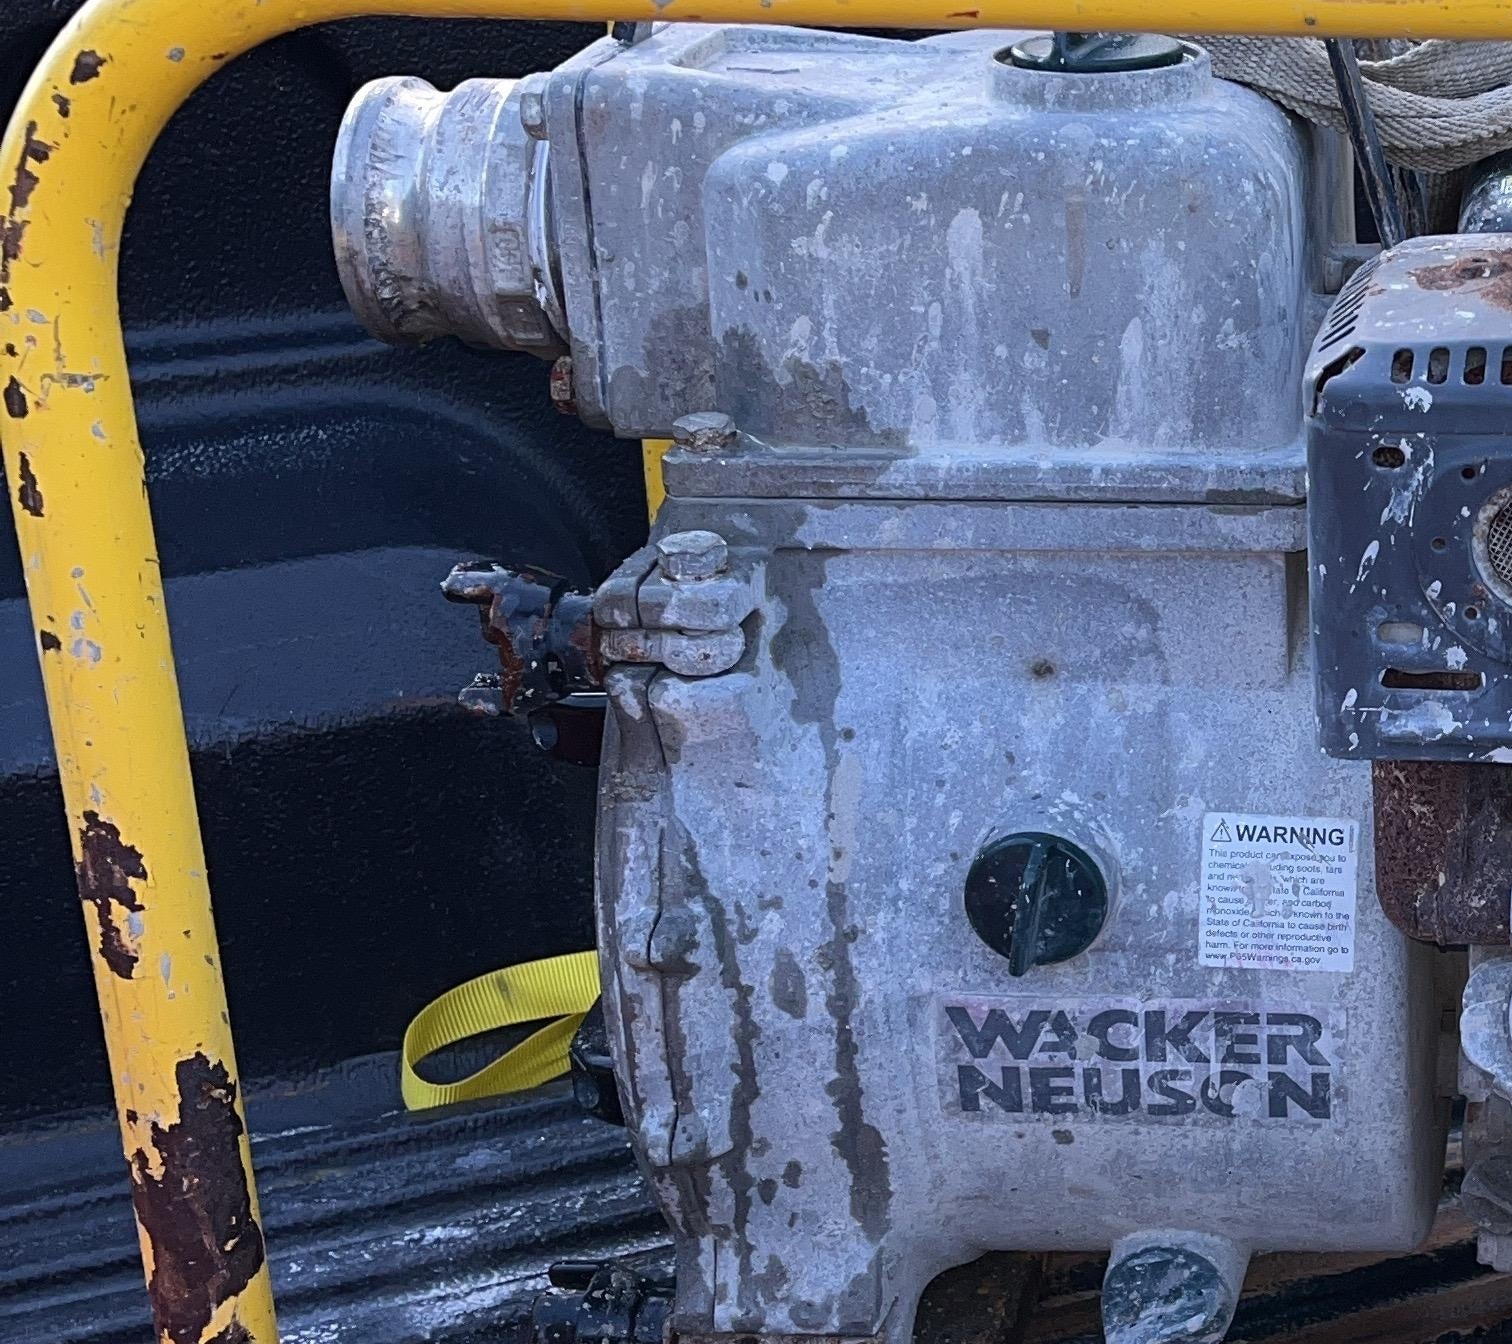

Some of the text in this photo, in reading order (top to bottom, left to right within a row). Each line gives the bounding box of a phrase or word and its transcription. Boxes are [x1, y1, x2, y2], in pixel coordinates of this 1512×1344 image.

[1235, 824, 1345, 846] WARNING
[1208, 848, 1228, 858] This
[1230, 851, 1264, 860] product
[1337, 854, 1347, 863] to
[1207, 873, 1225, 881] and
[1310, 877, 1325, 885] are
[1302, 886, 1346, 897] California
[1217, 896, 1244, 904] cause
[1293, 911, 1323, 919] known
[1325, 912, 1334, 920] to
[1335, 912, 1350, 920] the
[1206, 917, 1347, 931] State of California to cause birth
[1205, 929, 1332, 943] defects or other reproductive
[1205, 940, 1350, 956] harm. For more information go to
[944, 1005, 1332, 1068] WACKER
[957, 1064, 1332, 1120] NEUSON
